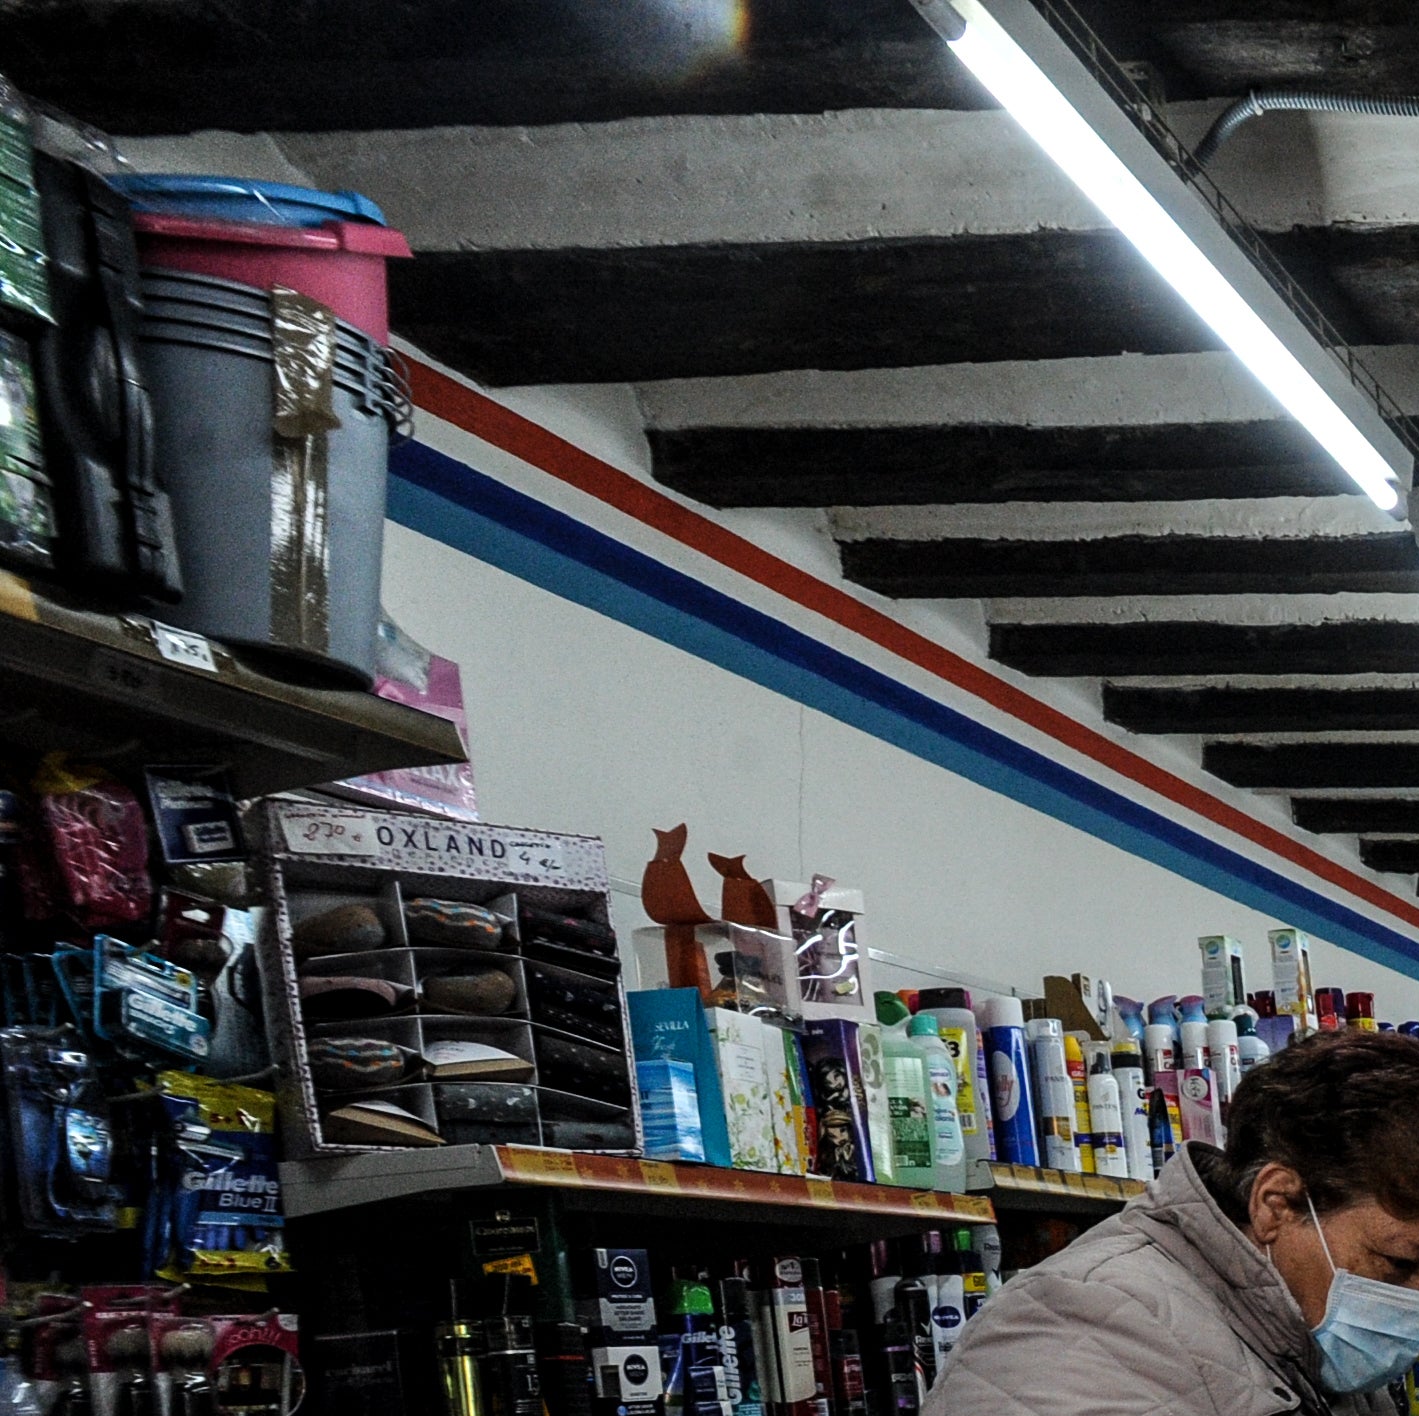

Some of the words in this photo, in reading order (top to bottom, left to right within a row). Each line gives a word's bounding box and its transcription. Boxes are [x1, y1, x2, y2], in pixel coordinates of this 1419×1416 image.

[376, 825, 507, 859] OXLAND
[182, 1171, 280, 1193] Gillette
[217, 1192, 262, 1209] Blue
[721, 1325, 742, 1405] Gillette
